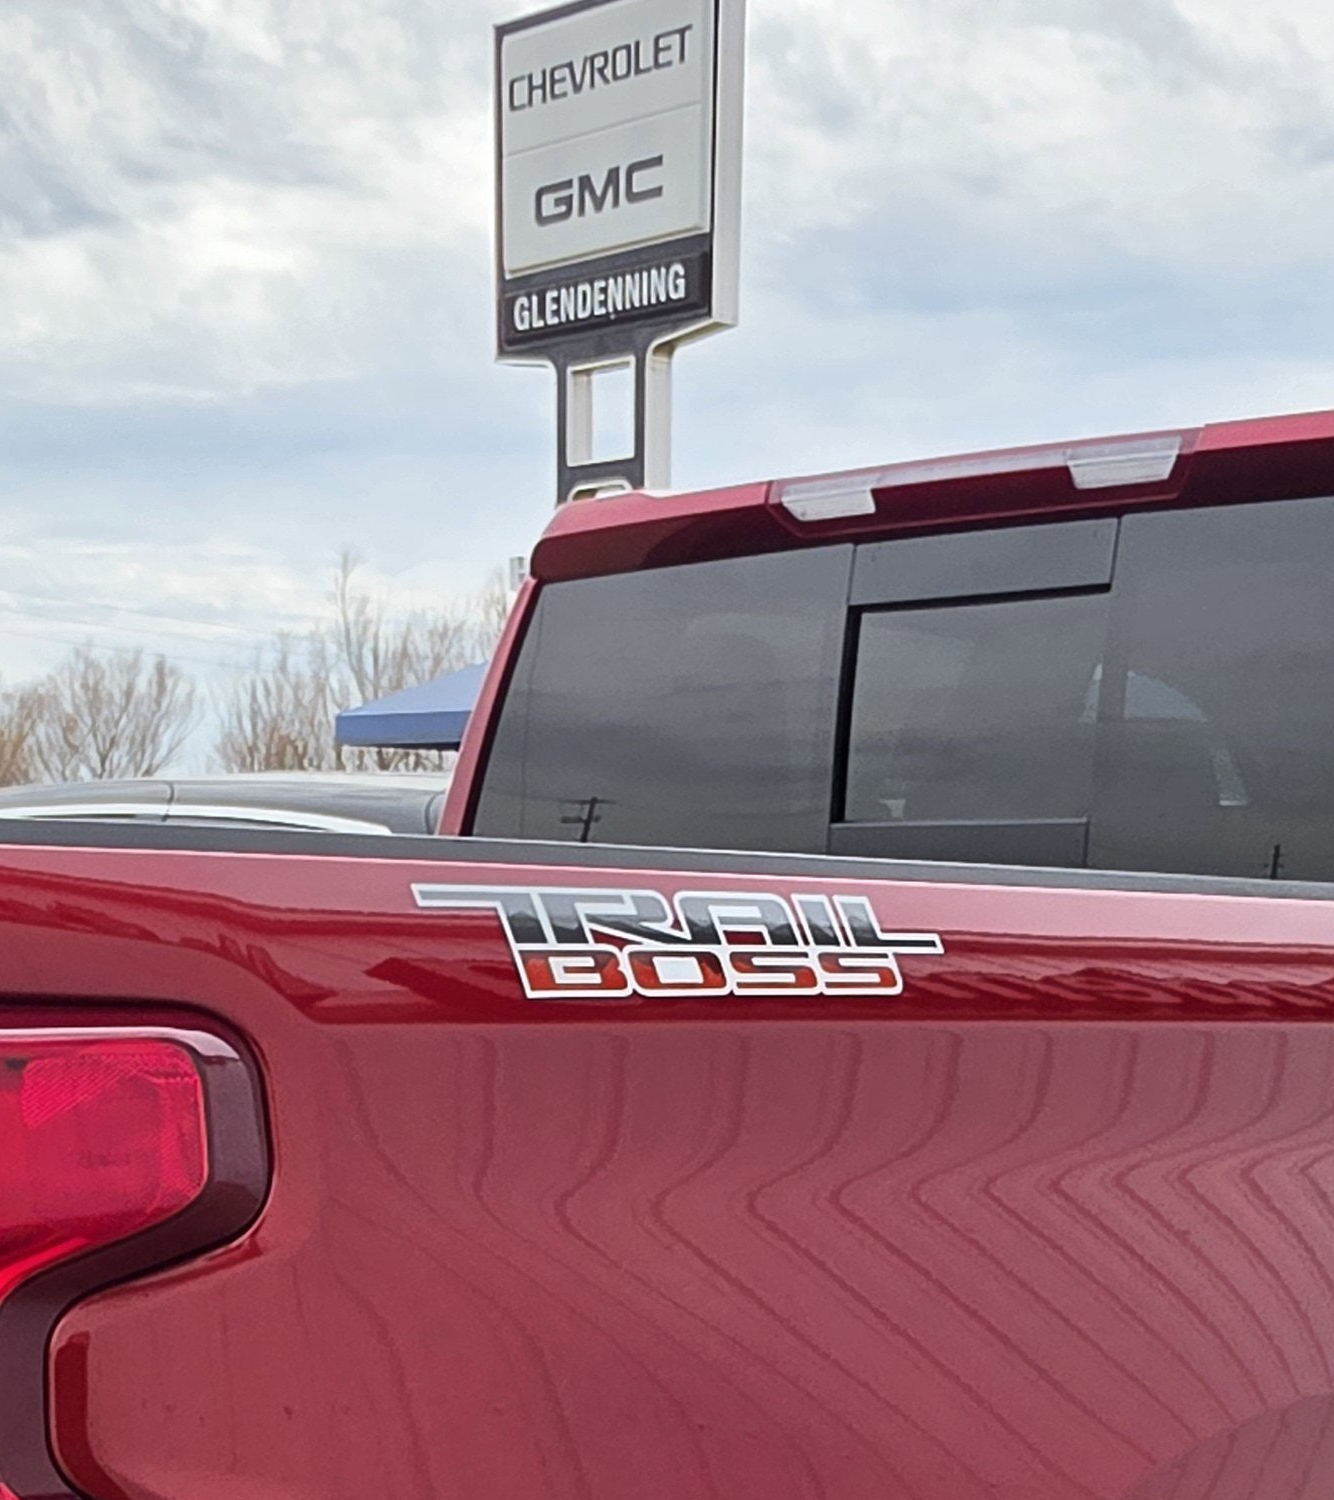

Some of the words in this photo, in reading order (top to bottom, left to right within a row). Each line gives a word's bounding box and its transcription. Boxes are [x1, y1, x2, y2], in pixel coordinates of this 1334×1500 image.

[508, 24, 693, 112] CHEVROLET
[534, 154, 664, 226] GMC
[513, 263, 686, 331] GLENDENNING
[410, 883, 944, 955] TRAIL
[516, 946, 904, 998] BOSS
